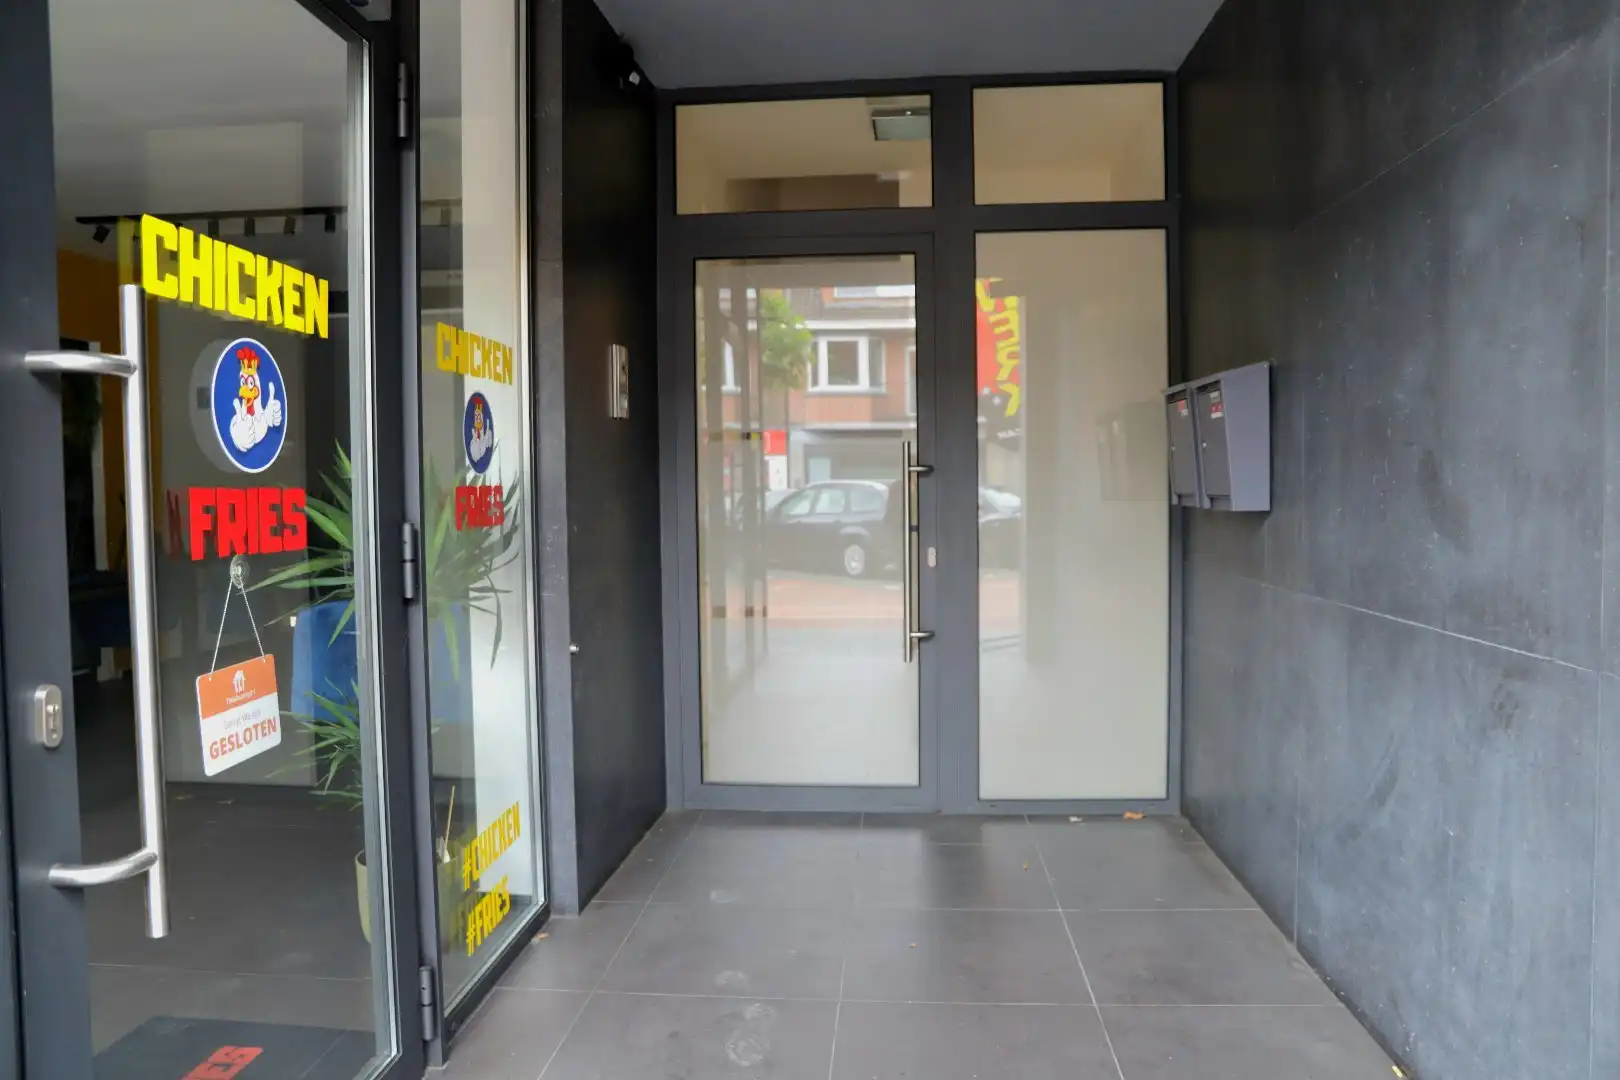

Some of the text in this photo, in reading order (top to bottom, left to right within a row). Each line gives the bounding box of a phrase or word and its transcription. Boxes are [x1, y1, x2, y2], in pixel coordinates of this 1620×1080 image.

[142, 213, 328, 339] CHICKEN
[436, 321, 513, 385] CHICKEN
[188, 486, 307, 561] FRIES
[455, 484, 504, 531] FRIES
[209, 717, 277, 760] GESLOTEN
[463, 800, 521, 891] #CHICKEN
[466, 875, 511, 956] #FRIES
